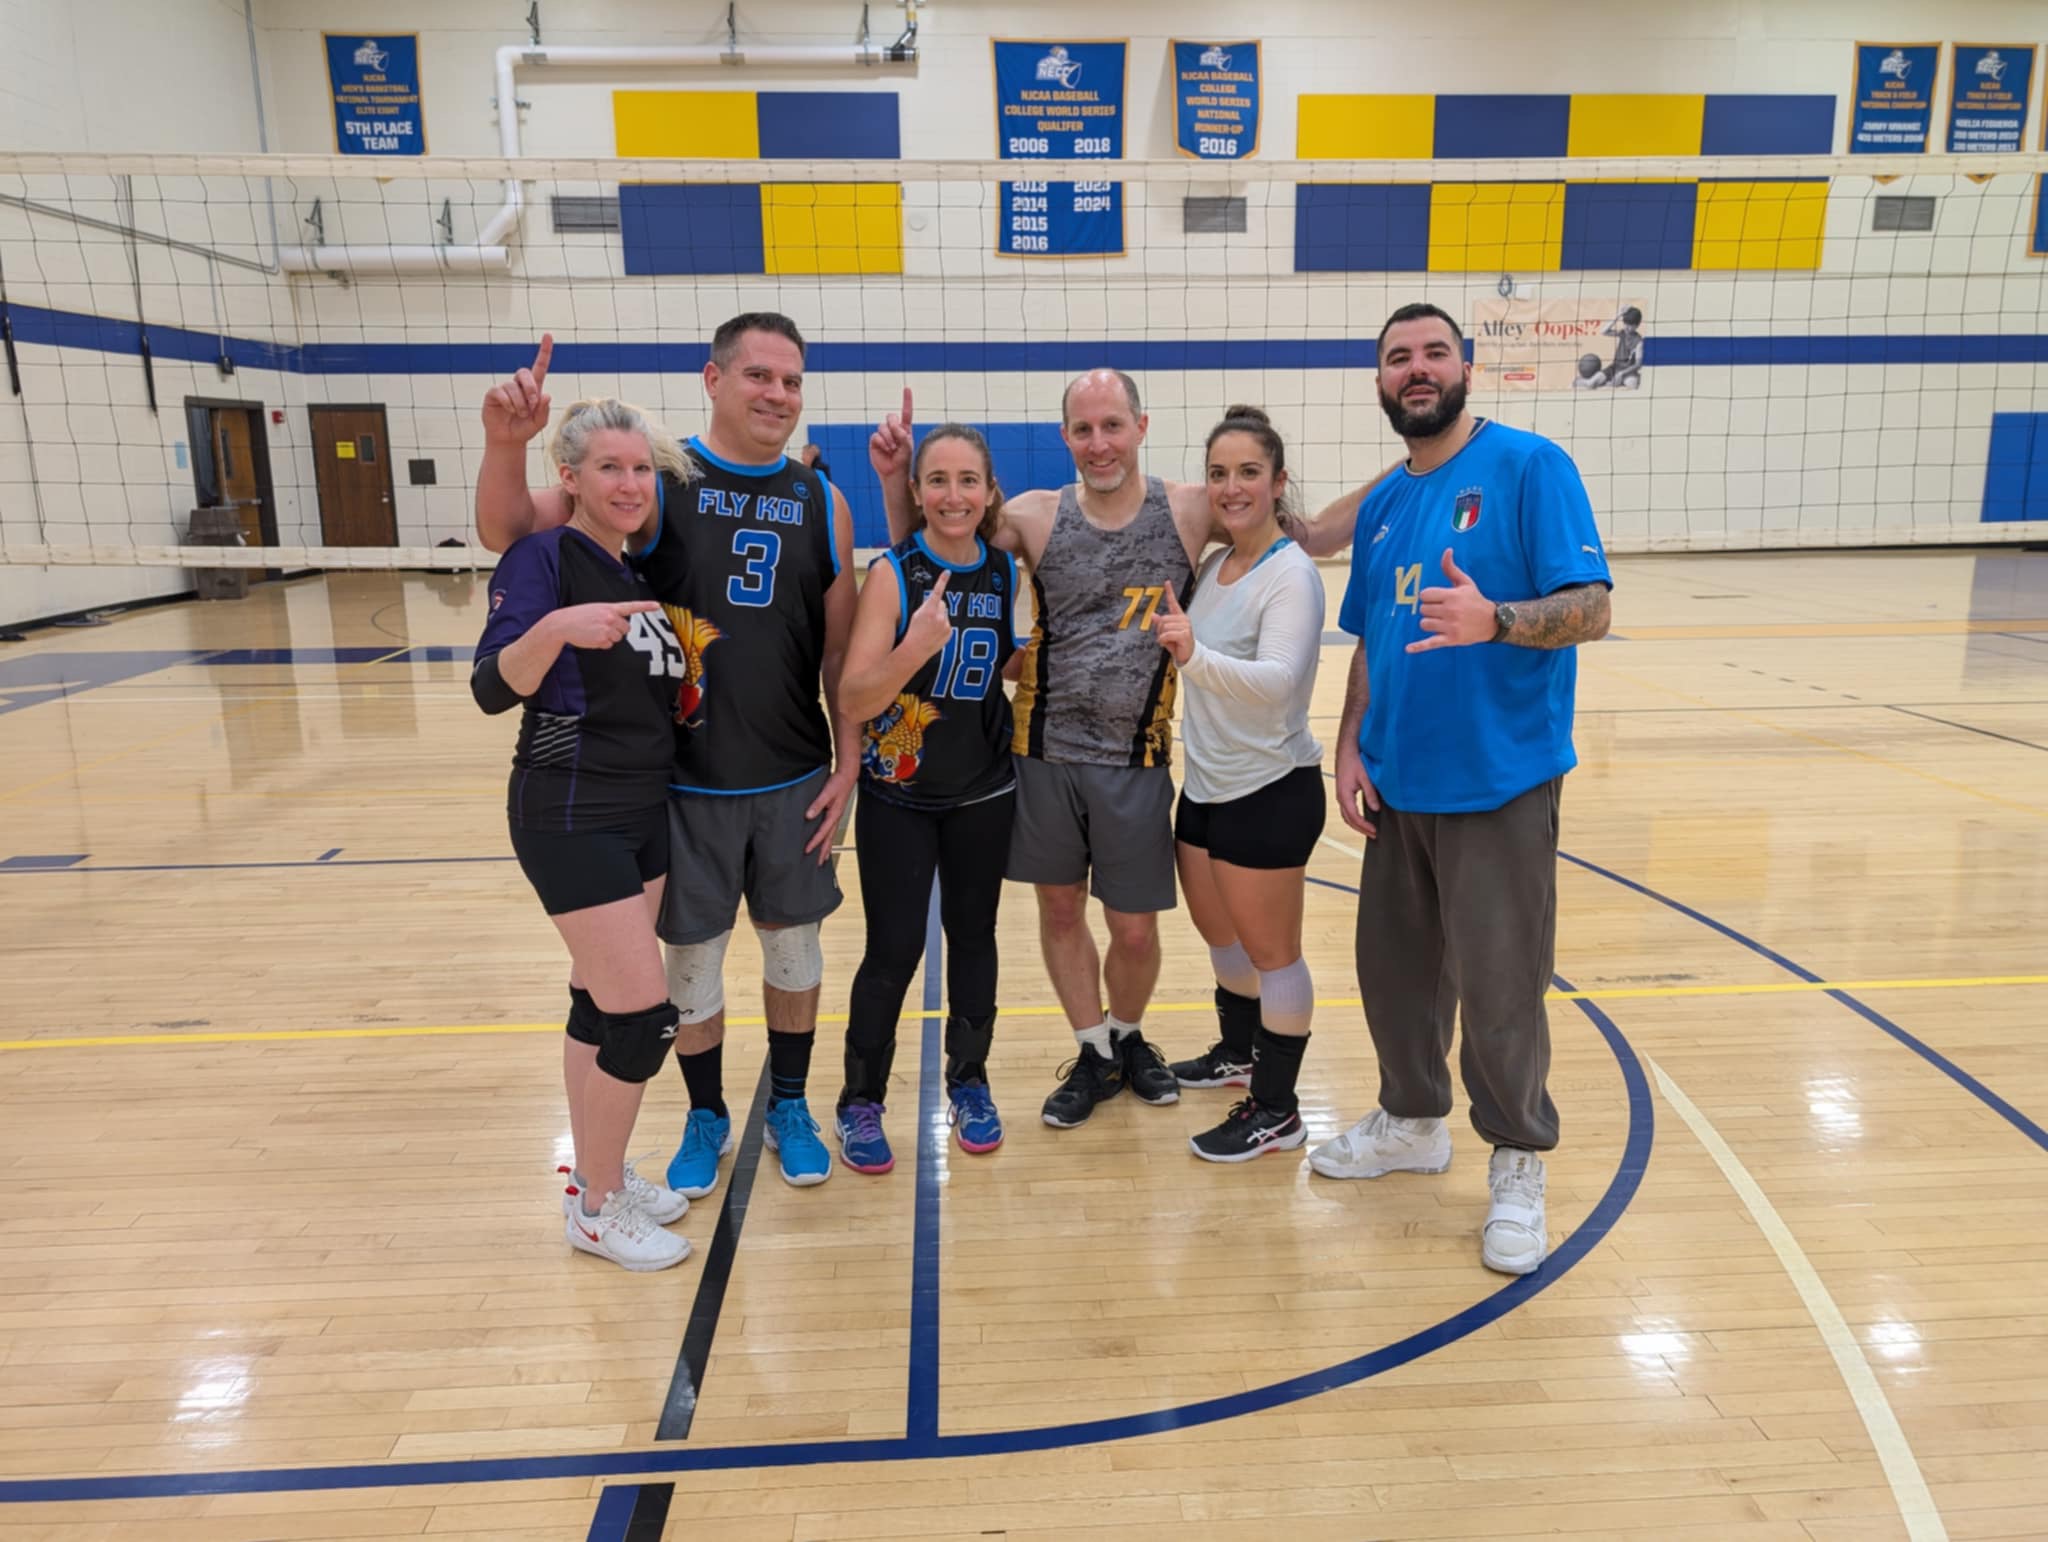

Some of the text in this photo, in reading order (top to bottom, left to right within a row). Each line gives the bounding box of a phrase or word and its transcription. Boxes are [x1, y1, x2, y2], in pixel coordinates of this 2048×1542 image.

[1036, 66, 1071, 80] NECC
[1181, 72, 1254, 82] NJCAA BASEBALL
[1021, 90, 1099, 101] NJCAA BASEBALL
[1200, 84, 1236, 94] COLLEGE
[336, 95, 418, 103] NATIONAL TOURNAMENT
[1186, 96, 1251, 108] WORLD SERIES
[1005, 105, 1116, 116] COLLEGE WORLD SERIES
[1197, 109, 1240, 120] NATIONAL
[345, 121, 413, 135] 5TH PLACE
[1194, 123, 1244, 134] RUNNER-UP
[362, 137, 399, 150] TEAM
[1009, 138, 1049, 153] 2006
[1074, 138, 1111, 153] 2018
[1199, 137, 1237, 155] 2016
[1012, 197, 1048, 212] 2014
[1073, 196, 1111, 212] 2024
[1012, 216, 1048, 232] 2015
[1012, 235, 1048, 251] 2016
[1478, 319, 1601, 341] Alley Oops!?
[698, 488, 803, 525] FLY KOI
[727, 528, 781, 607] 3
[968, 592, 1002, 620] KOI
[1118, 586, 1165, 631] 77
[626, 604, 687, 679] 45
[931, 627, 999, 700] 18
